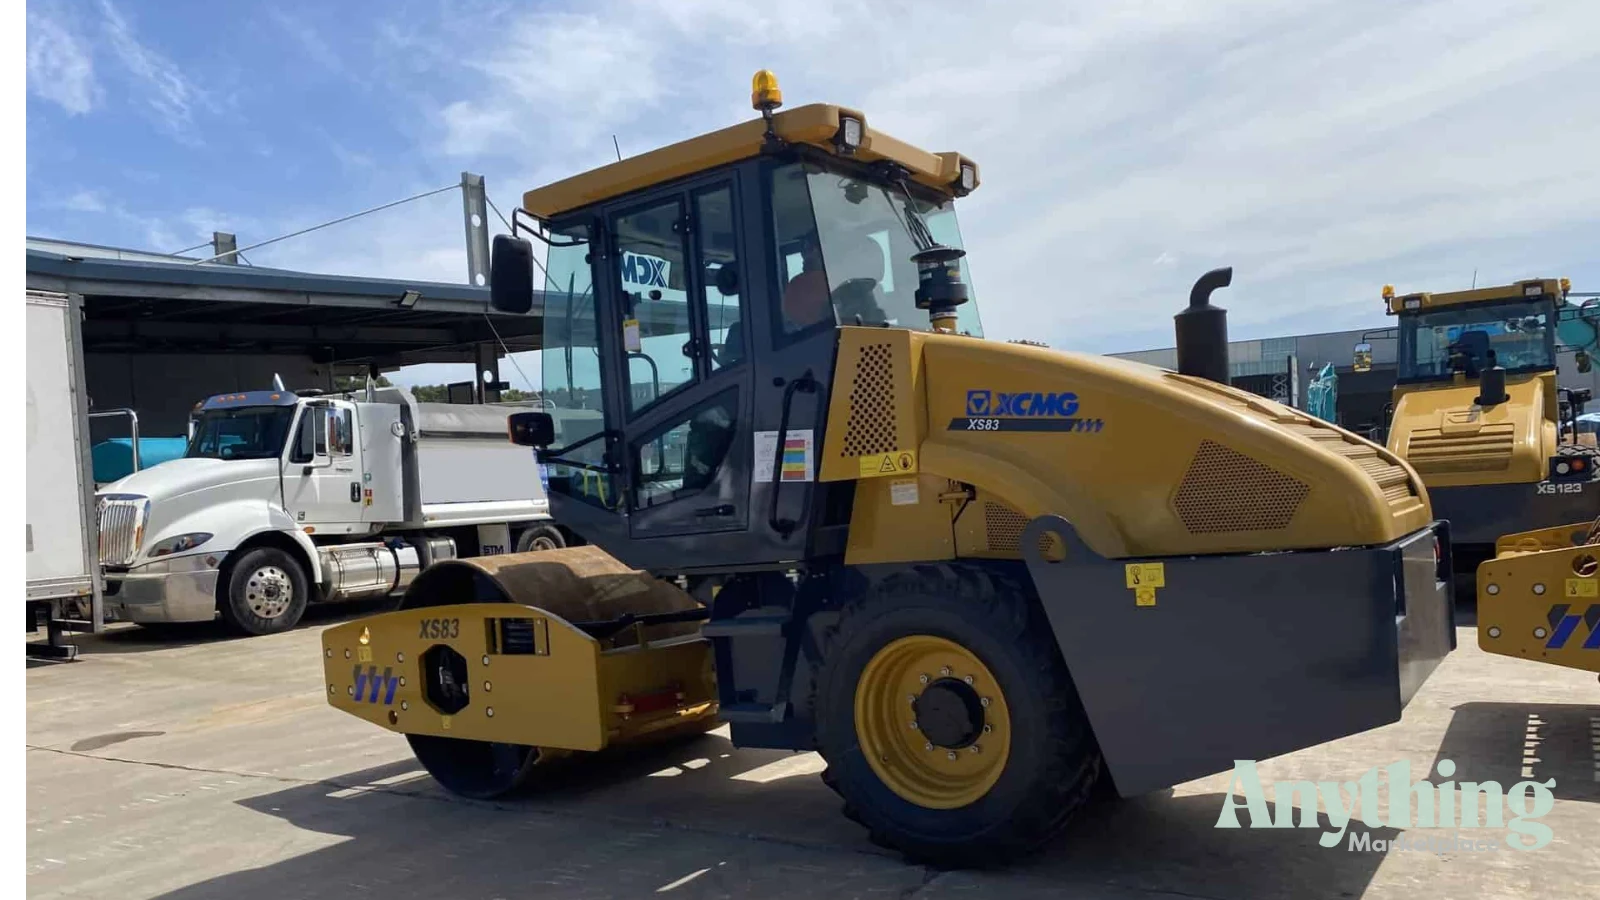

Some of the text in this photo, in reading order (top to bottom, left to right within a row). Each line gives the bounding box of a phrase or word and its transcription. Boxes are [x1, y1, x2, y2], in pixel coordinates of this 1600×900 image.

[992, 392, 1079, 417] XCMG
[967, 418, 1000, 431] XS83
[1537, 483, 1583, 494] XS123
[419, 618, 460, 639] XS83
